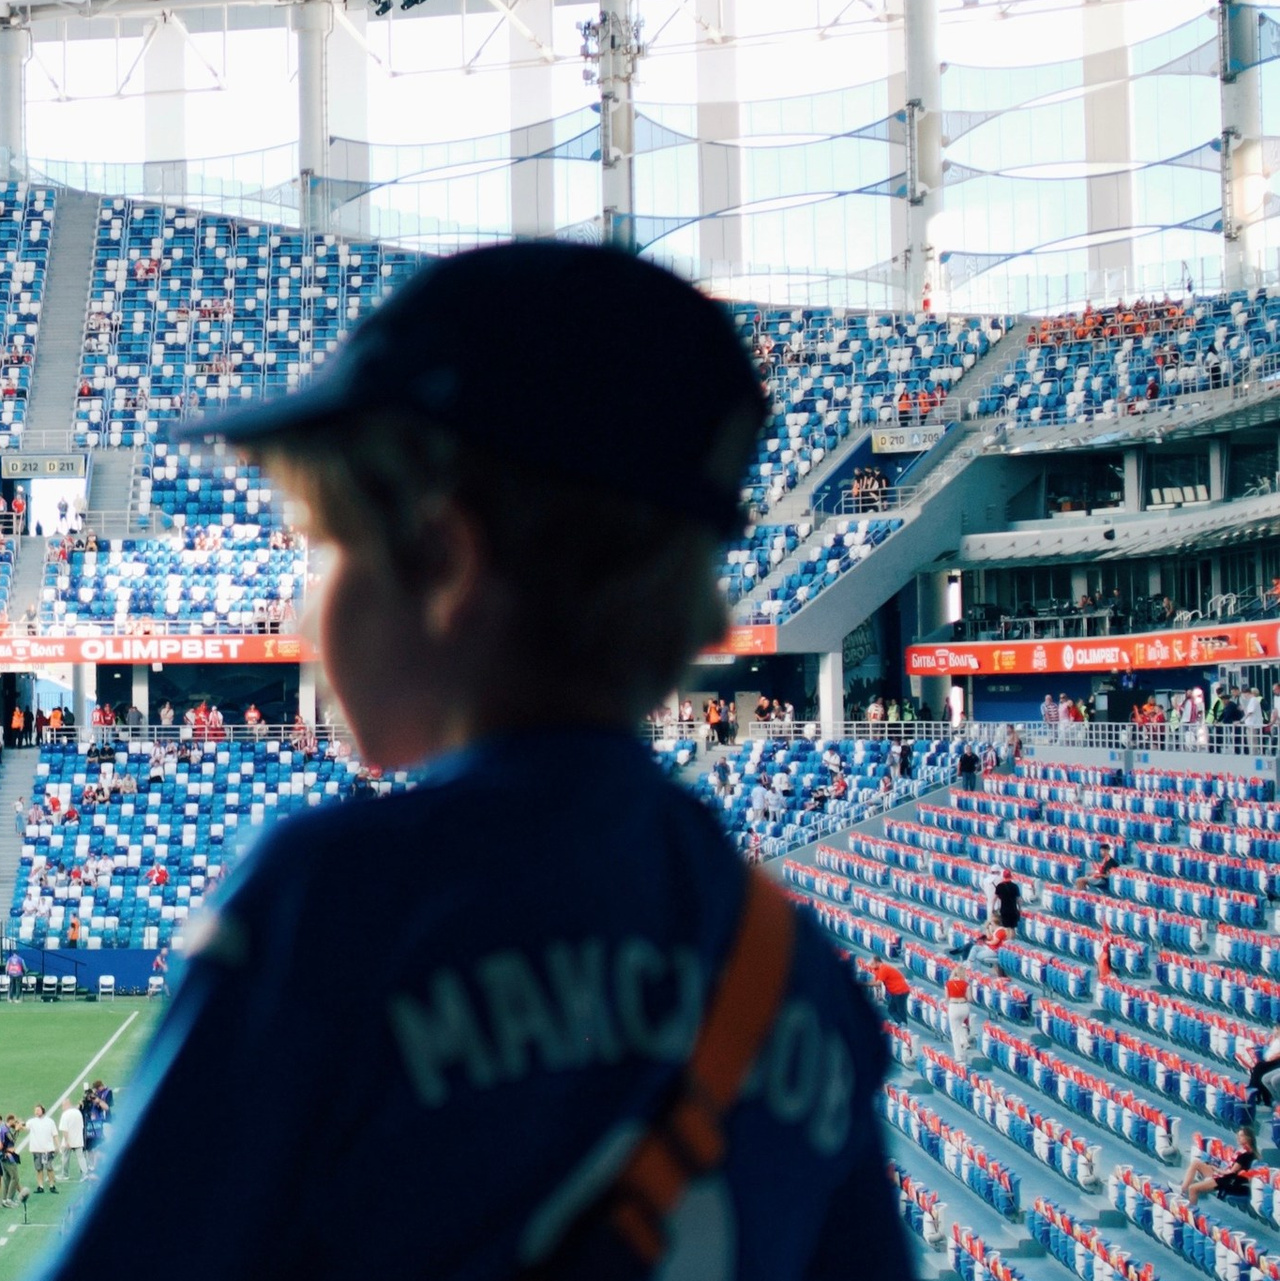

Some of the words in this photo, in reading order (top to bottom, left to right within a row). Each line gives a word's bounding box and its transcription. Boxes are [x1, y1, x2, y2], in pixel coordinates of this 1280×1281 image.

[889, 435, 905, 446] 210
[11, 463, 18, 472] D
[22, 462, 38, 472] 212
[48, 462, 56, 471] D
[60, 462, 74, 471] 211
[80, 639, 244, 660] OLIMPBET
[1075, 647, 1120, 665] OLIMPBET
